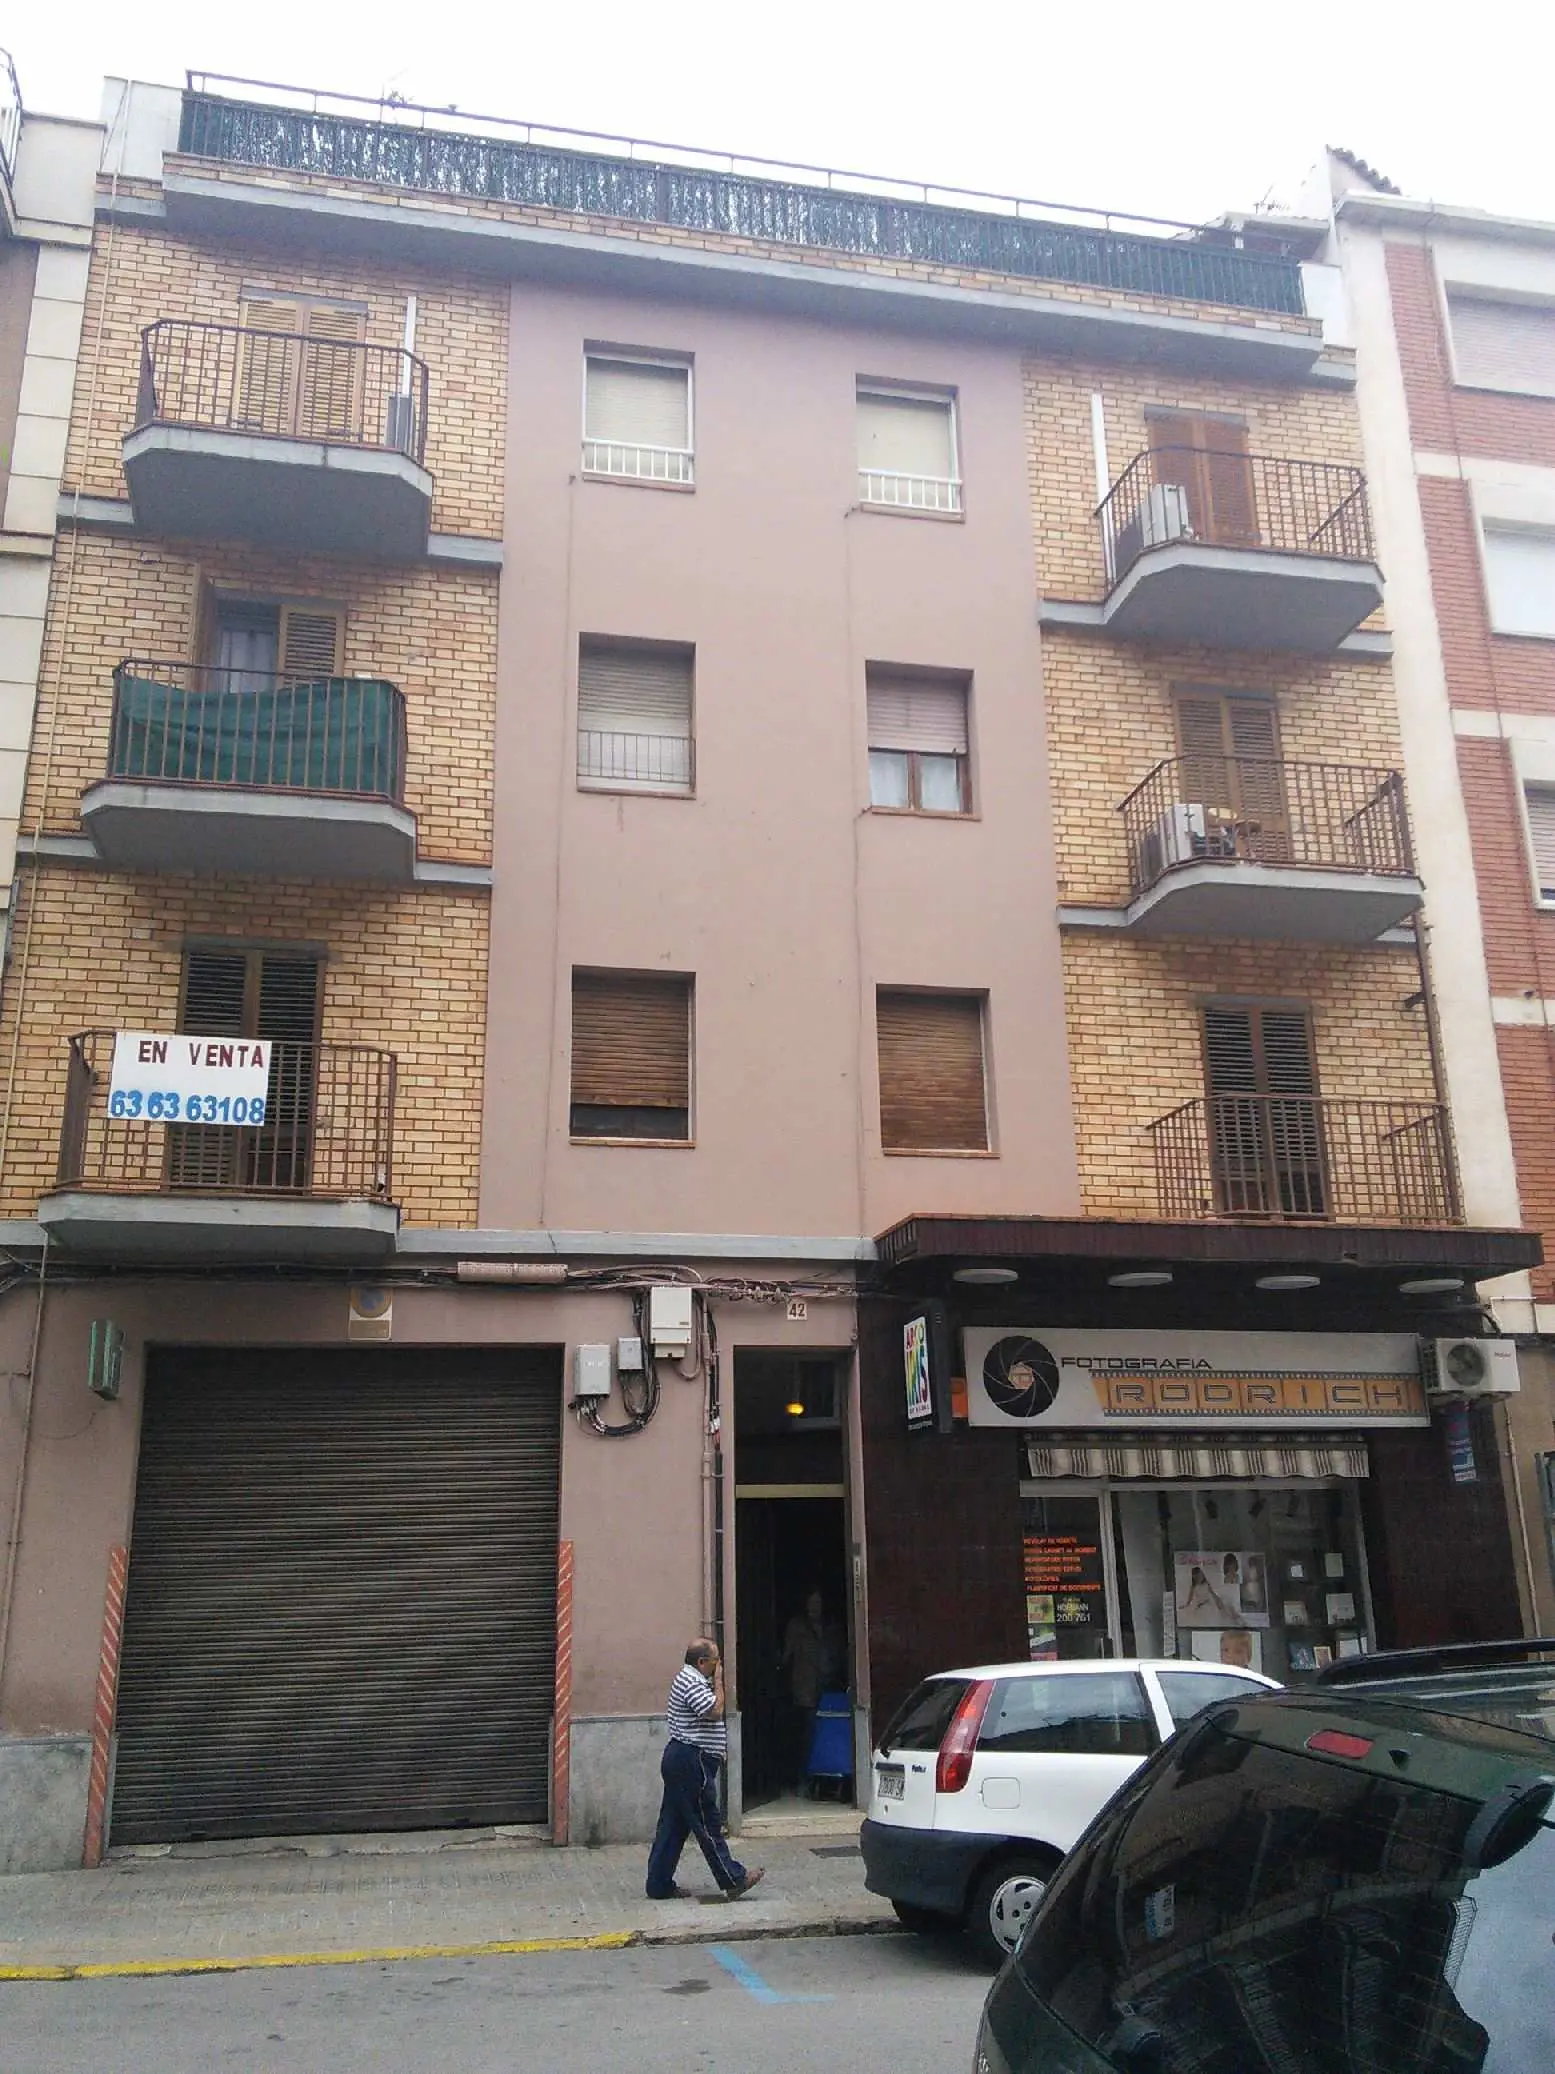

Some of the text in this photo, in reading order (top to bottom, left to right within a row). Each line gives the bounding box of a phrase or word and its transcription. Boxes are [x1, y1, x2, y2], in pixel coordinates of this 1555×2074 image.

[138, 1040, 264, 1068] EN VENTA
[789, 1303, 805, 1317] 42
[1060, 1356, 1213, 1370] FOTOGRAFIA
[1115, 1384, 1403, 1406] RODRICH
